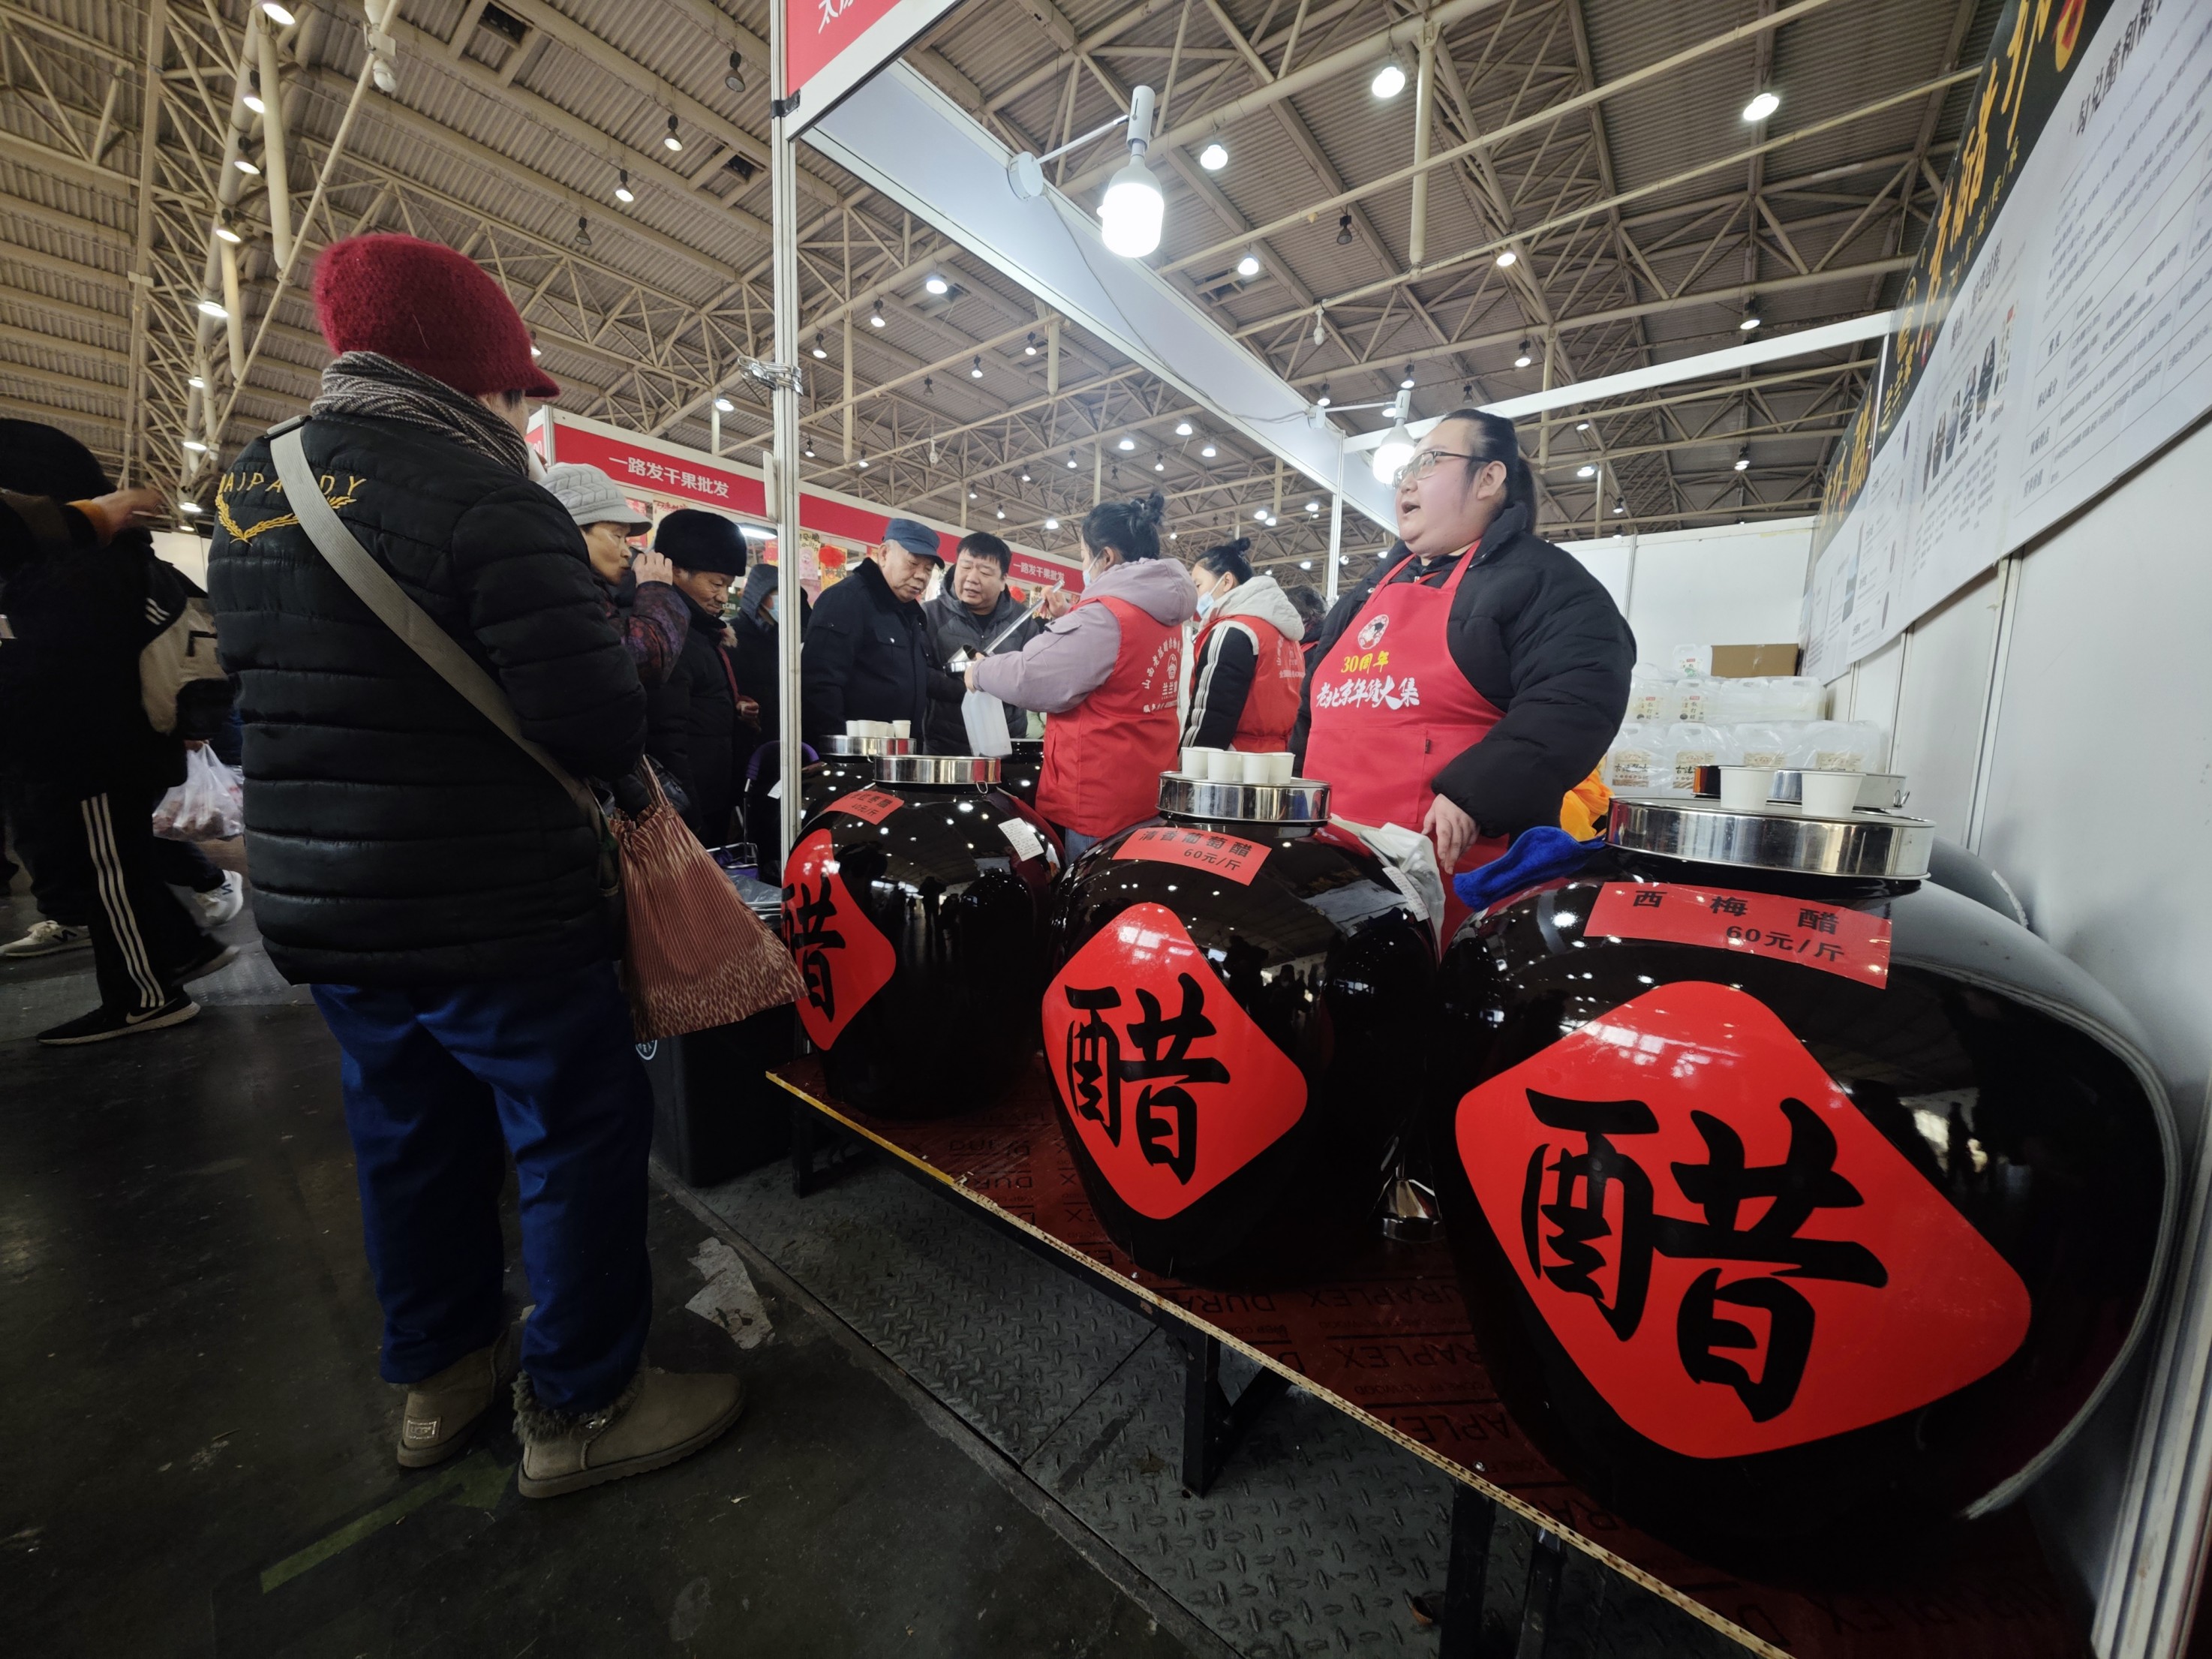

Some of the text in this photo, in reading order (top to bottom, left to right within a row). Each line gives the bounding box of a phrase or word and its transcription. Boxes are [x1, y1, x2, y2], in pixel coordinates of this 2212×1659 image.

[609, 456, 729, 499] 一路发干果批发
[1013, 562, 1065, 582] 一路发干果批发
[1340, 651, 1389, 674] 30周年
[1315, 675, 1420, 711] 老北京年货大集
[1138, 830, 1252, 858] 清香葡萄醋
[1183, 848, 1243, 871] 60元/斤
[1633, 889, 1839, 936] 西梅醋
[1726, 925, 1845, 963] 60元/斤
[1064, 972, 1231, 1186] 醋
[1521, 1087, 1889, 1423] 醋
